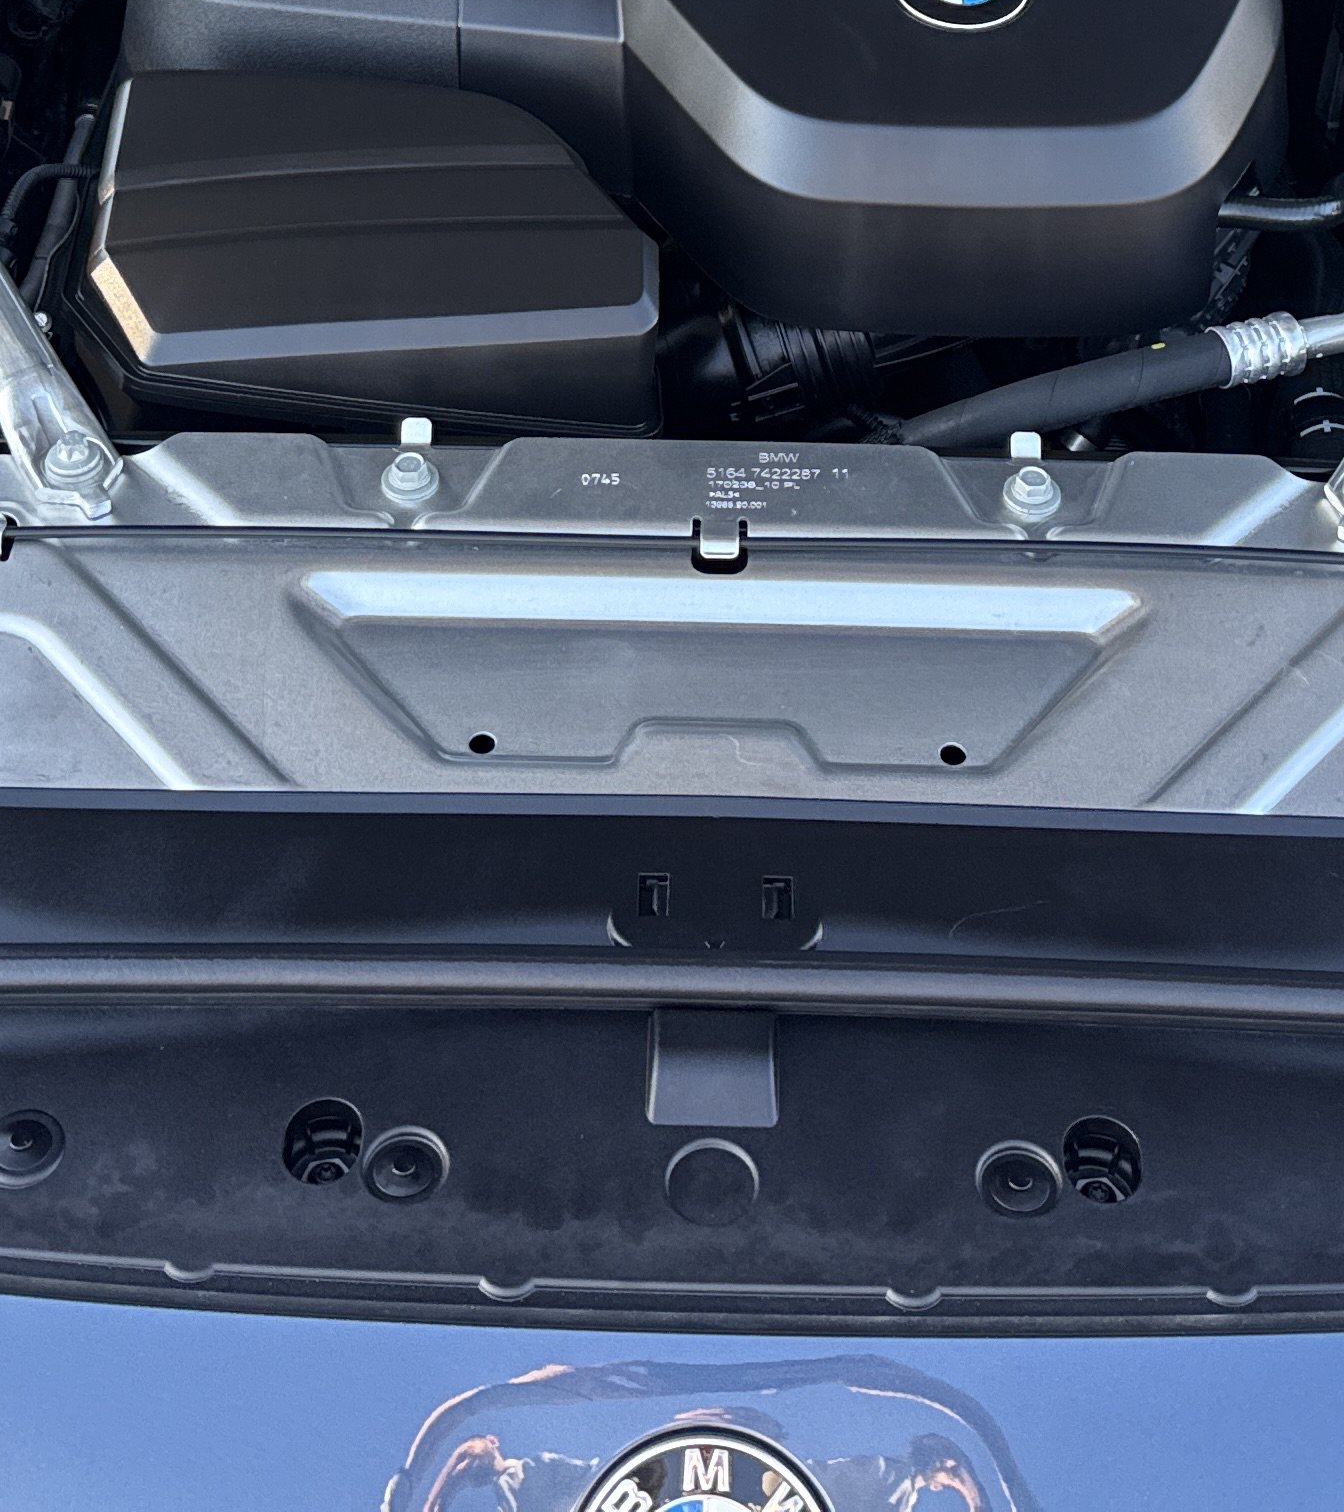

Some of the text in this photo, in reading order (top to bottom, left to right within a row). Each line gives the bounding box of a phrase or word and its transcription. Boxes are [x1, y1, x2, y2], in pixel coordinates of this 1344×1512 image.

[758, 452, 800, 464] BMW
[581, 473, 620, 486] 0745
[706, 467, 849, 480] 5164 7422287 11
